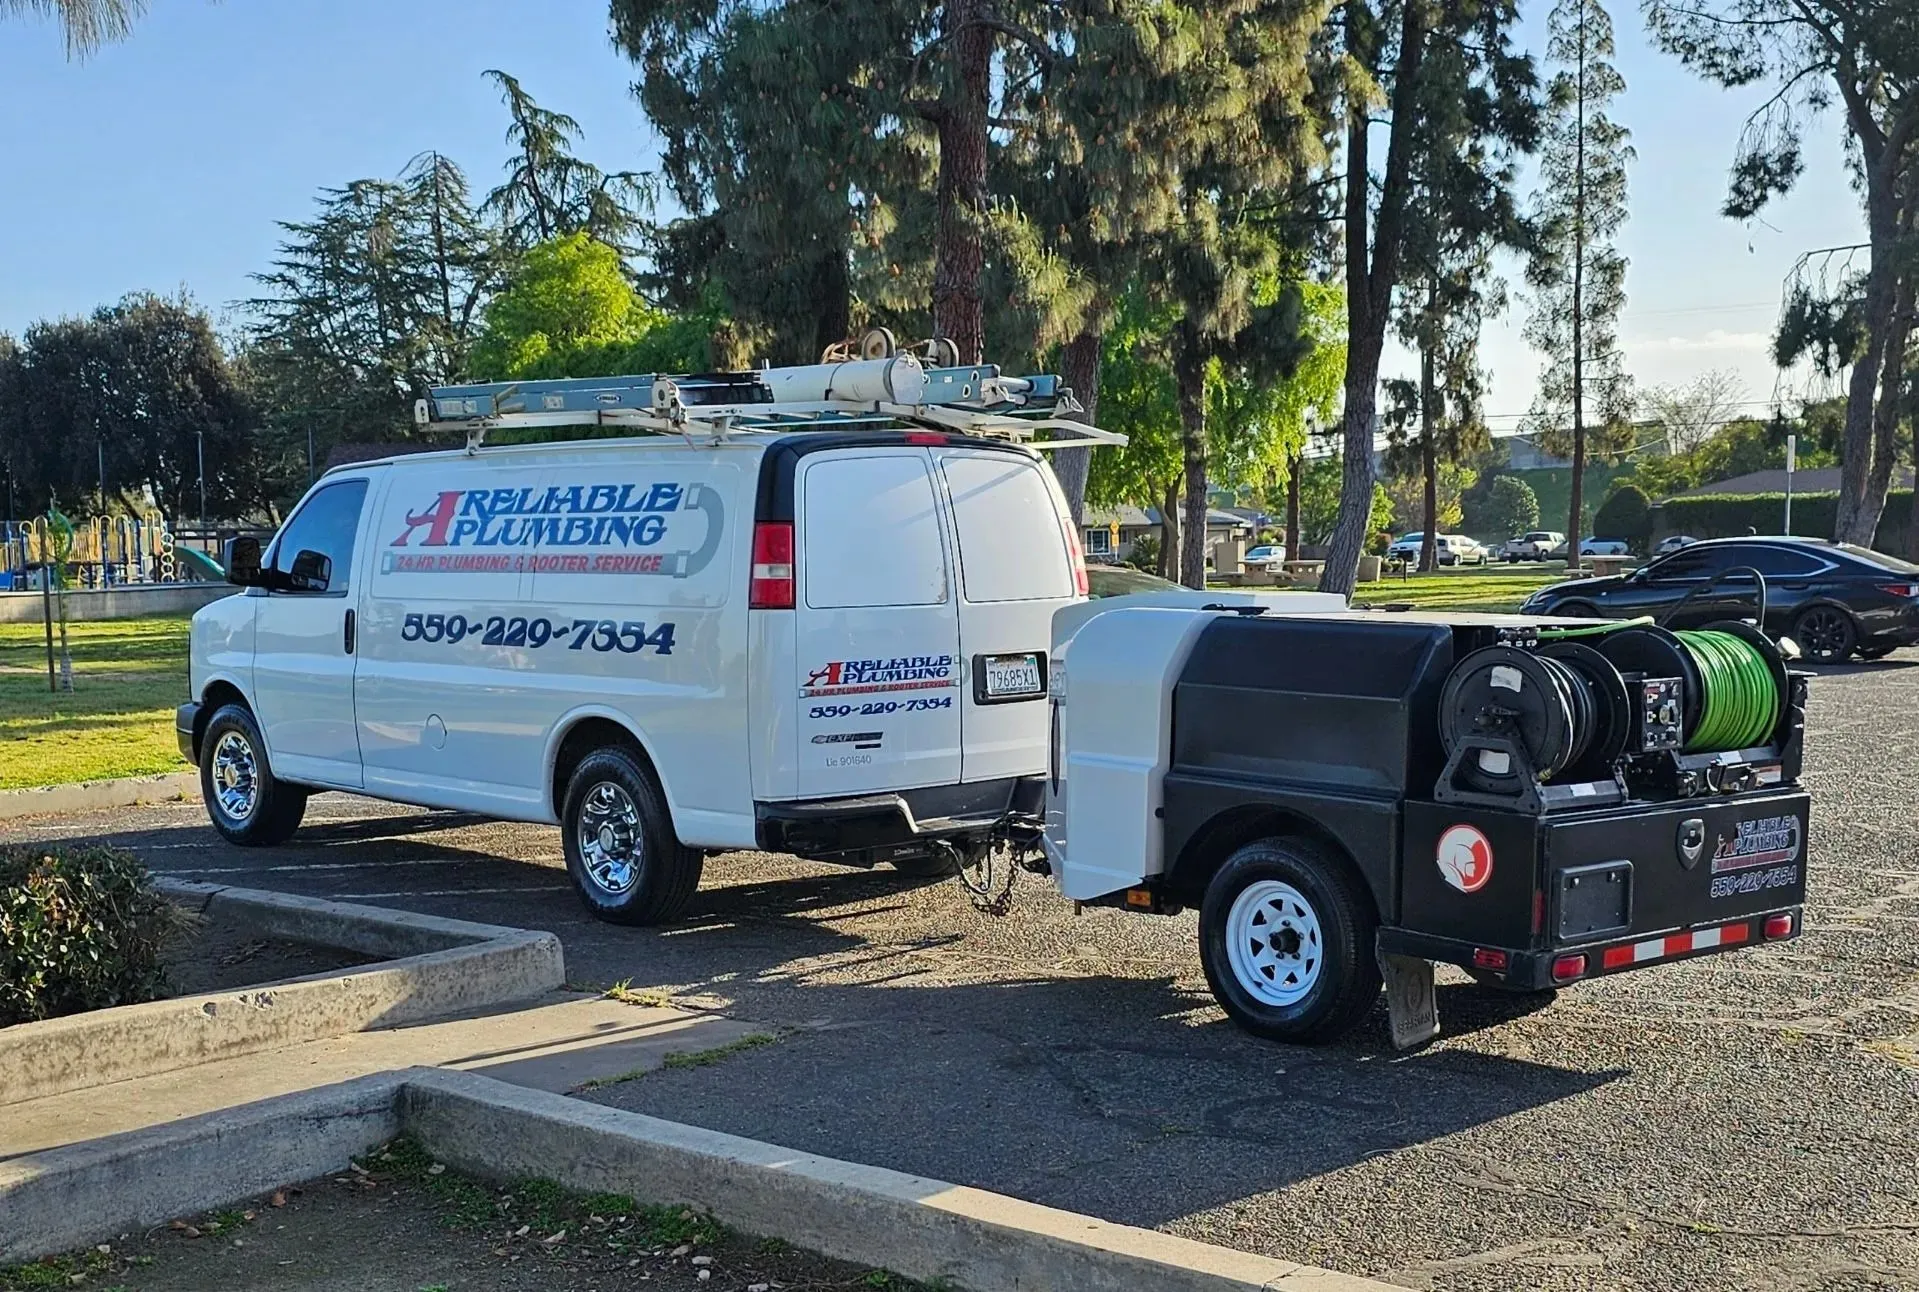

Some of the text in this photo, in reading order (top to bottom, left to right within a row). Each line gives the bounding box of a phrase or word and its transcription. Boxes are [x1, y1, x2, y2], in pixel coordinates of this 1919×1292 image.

[390, 483, 684, 547] A RELIABLE
[449, 515, 668, 548] PLUMBING
[417, 556, 434, 570] HR
[439, 555, 510, 571] PLUMBING
[528, 555, 589, 571] ROOTER
[592, 555, 663, 572] SERVICE
[401, 613, 676, 655] 559-229-7354
[844, 655, 952, 673] RELIABLE
[842, 667, 950, 684] PLUMBING
[989, 668, 1037, 689] 79685X1
[809, 697, 952, 718] 559-229-7354
